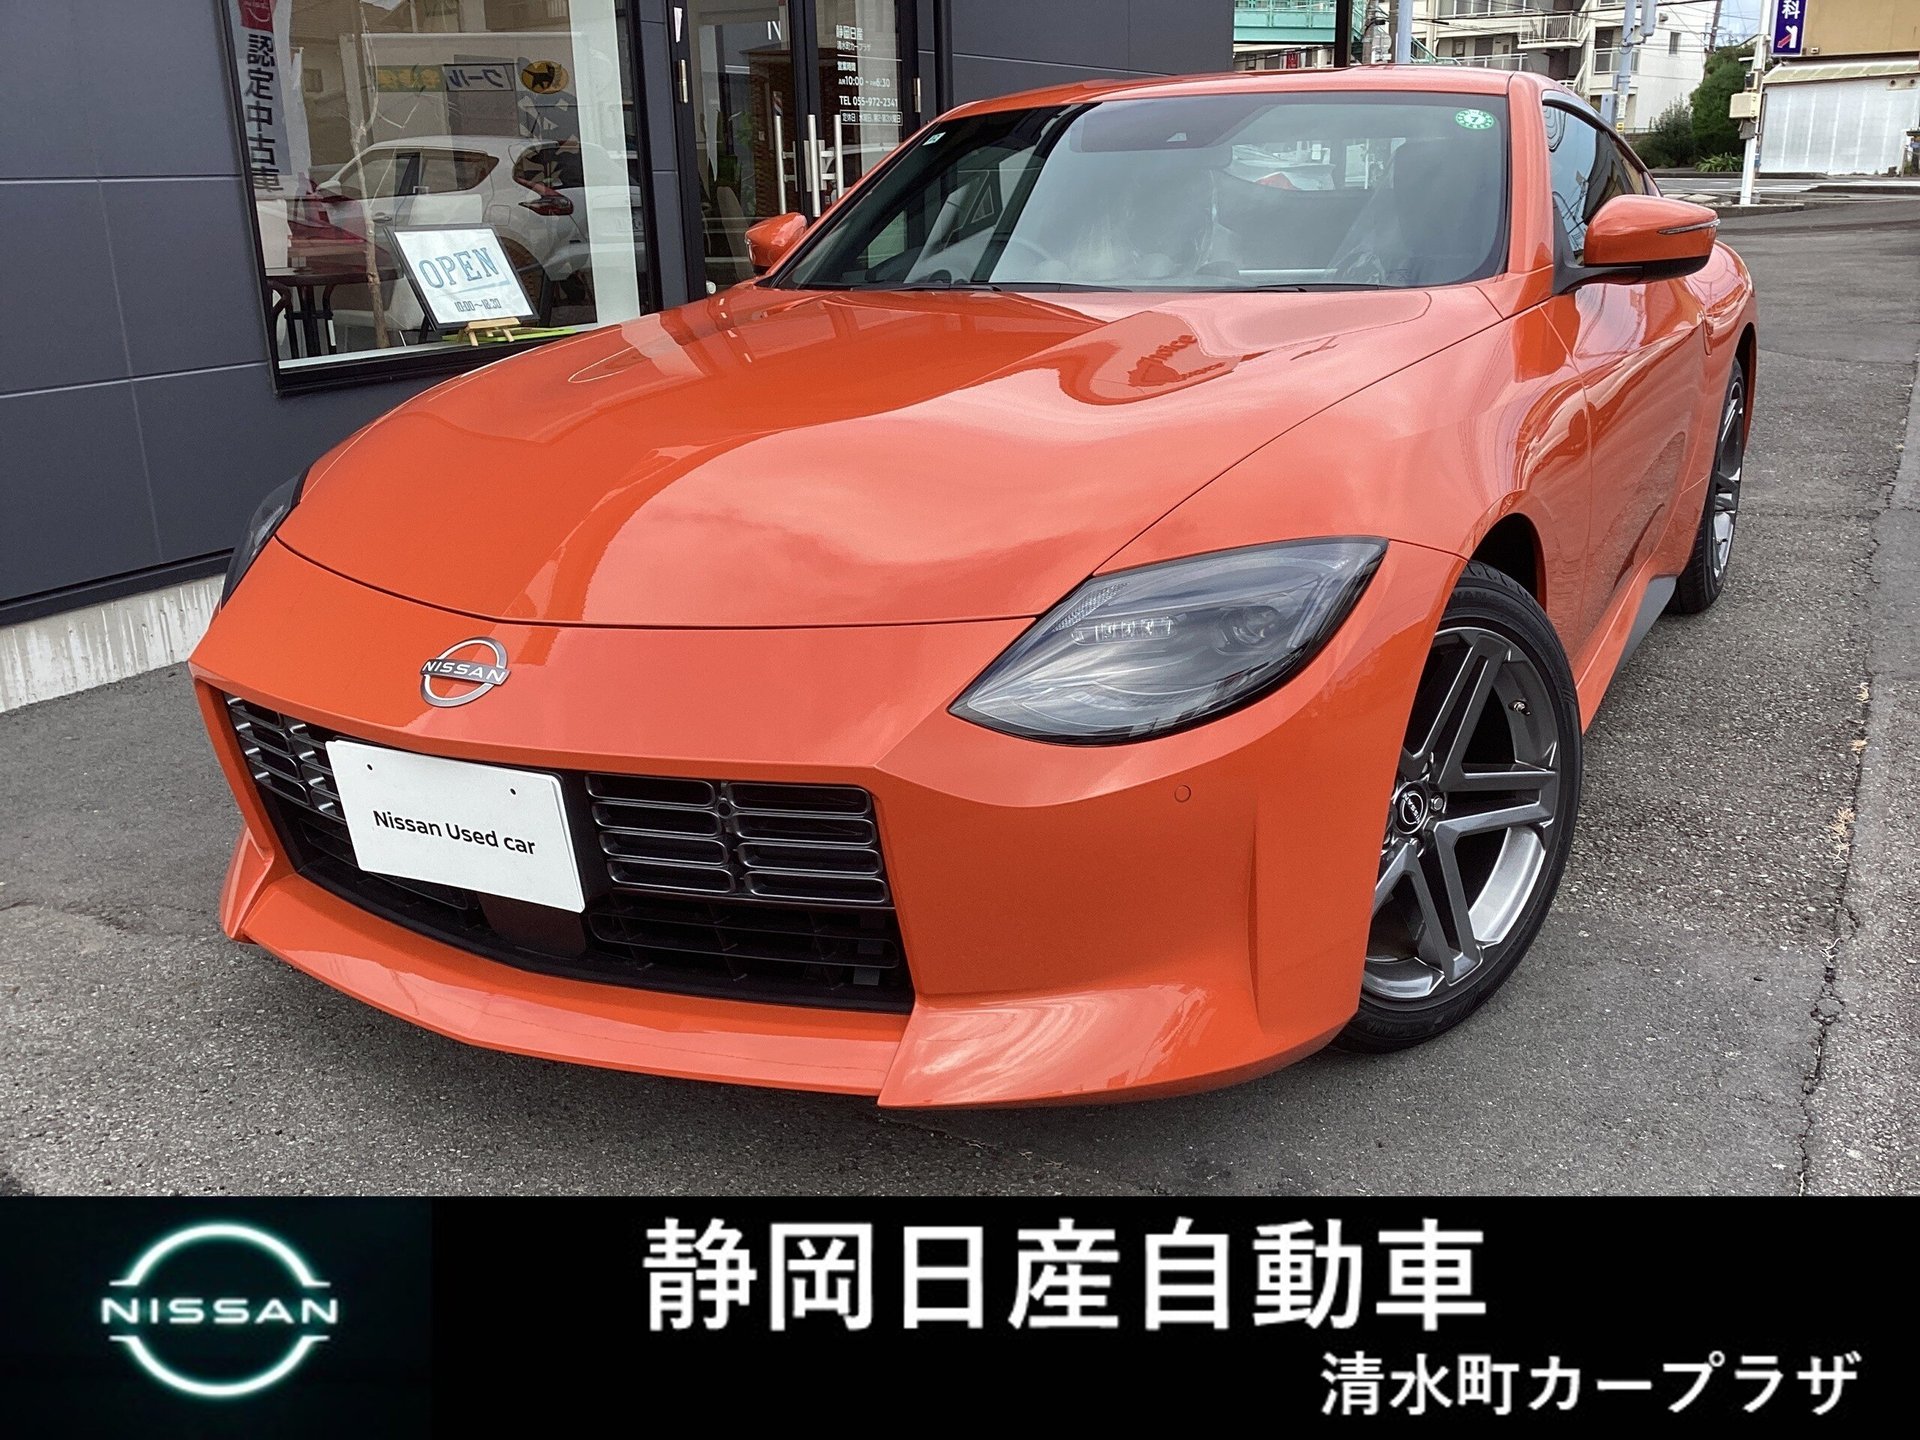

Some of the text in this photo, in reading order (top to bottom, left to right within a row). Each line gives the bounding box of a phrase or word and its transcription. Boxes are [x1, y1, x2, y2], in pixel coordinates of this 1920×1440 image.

[245, 33, 284, 192] 認定中古車
[838, 95, 898, 108] TEL 055-972-2341
[418, 247, 499, 289] OPEN
[422, 660, 505, 684] NISSAN
[373, 810, 537, 855] Nissan Used car
